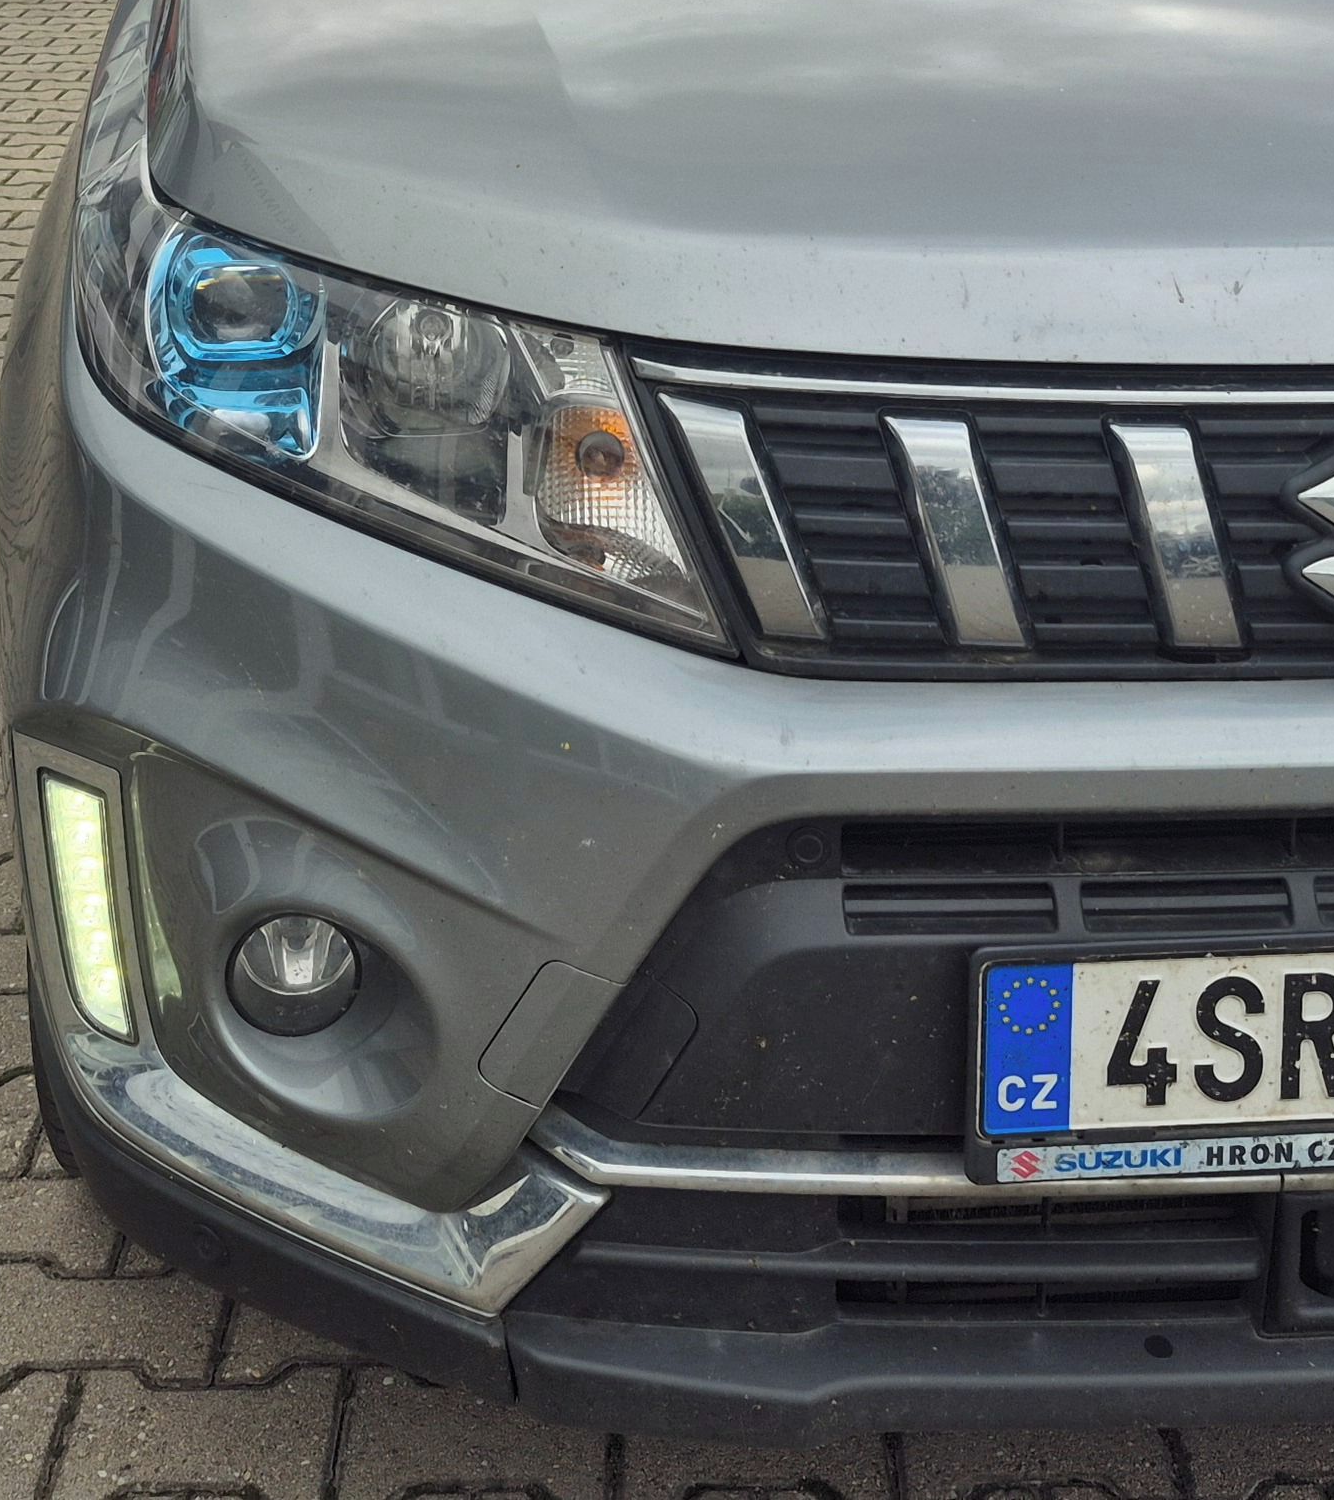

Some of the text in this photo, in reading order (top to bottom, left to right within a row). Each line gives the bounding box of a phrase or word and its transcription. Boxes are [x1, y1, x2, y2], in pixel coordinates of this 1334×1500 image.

[997, 1073, 1059, 1113] CZ
[1054, 1147, 1182, 1173] SUZUKI
[1206, 1142, 1295, 1167] HRON
